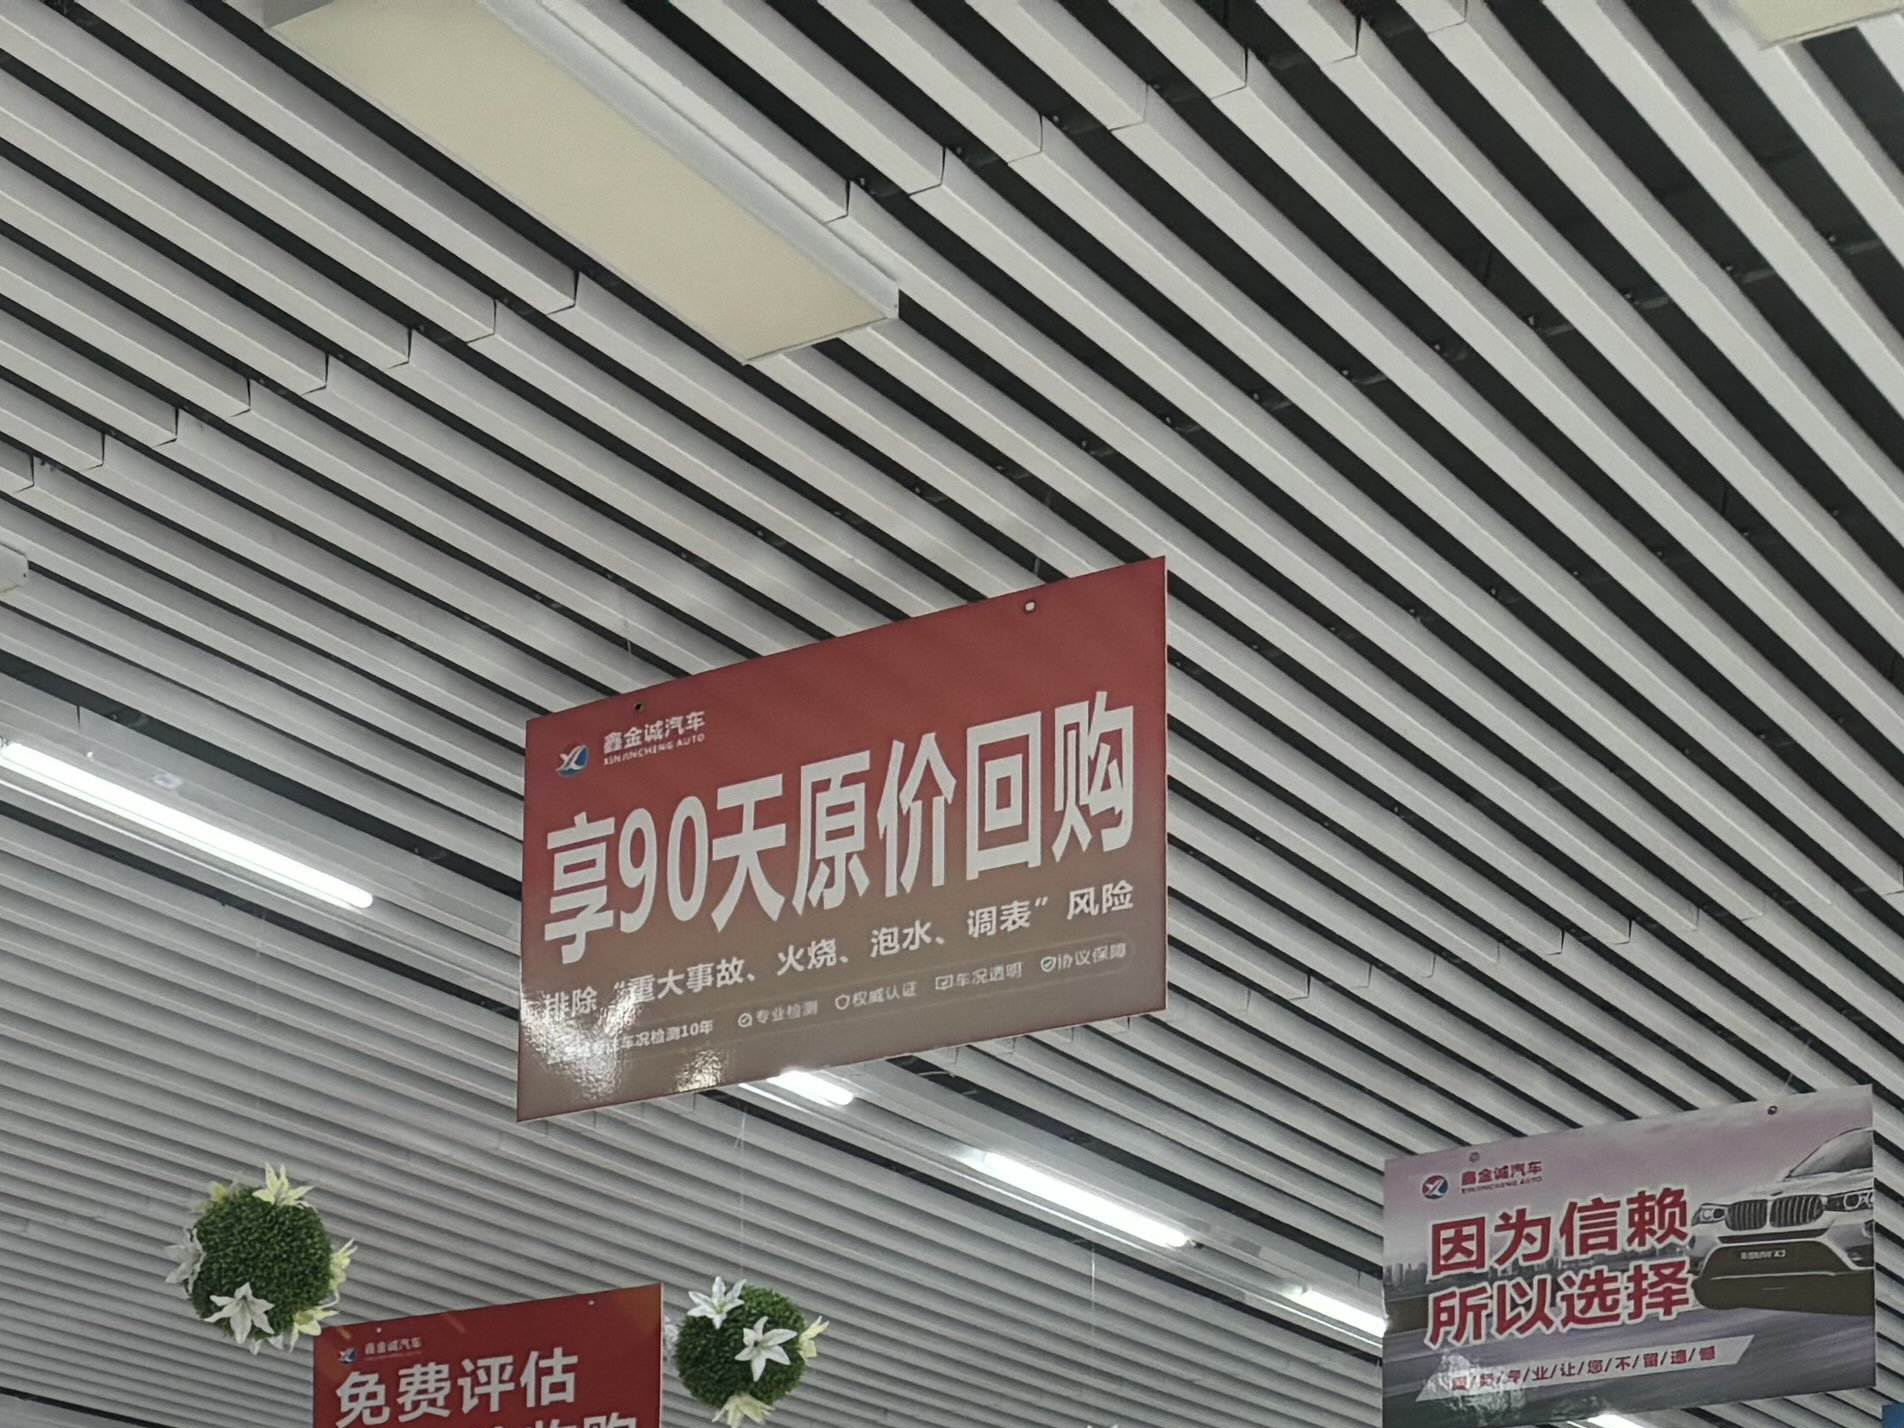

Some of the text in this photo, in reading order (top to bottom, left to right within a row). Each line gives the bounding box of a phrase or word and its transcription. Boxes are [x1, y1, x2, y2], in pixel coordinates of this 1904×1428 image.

[676, 733, 706, 748] AUTO
[543, 690, 1135, 966] 享90天原价回购
[1428, 1187, 1691, 1277] 因为信赖
[1426, 1261, 1694, 1350] 所以选择
